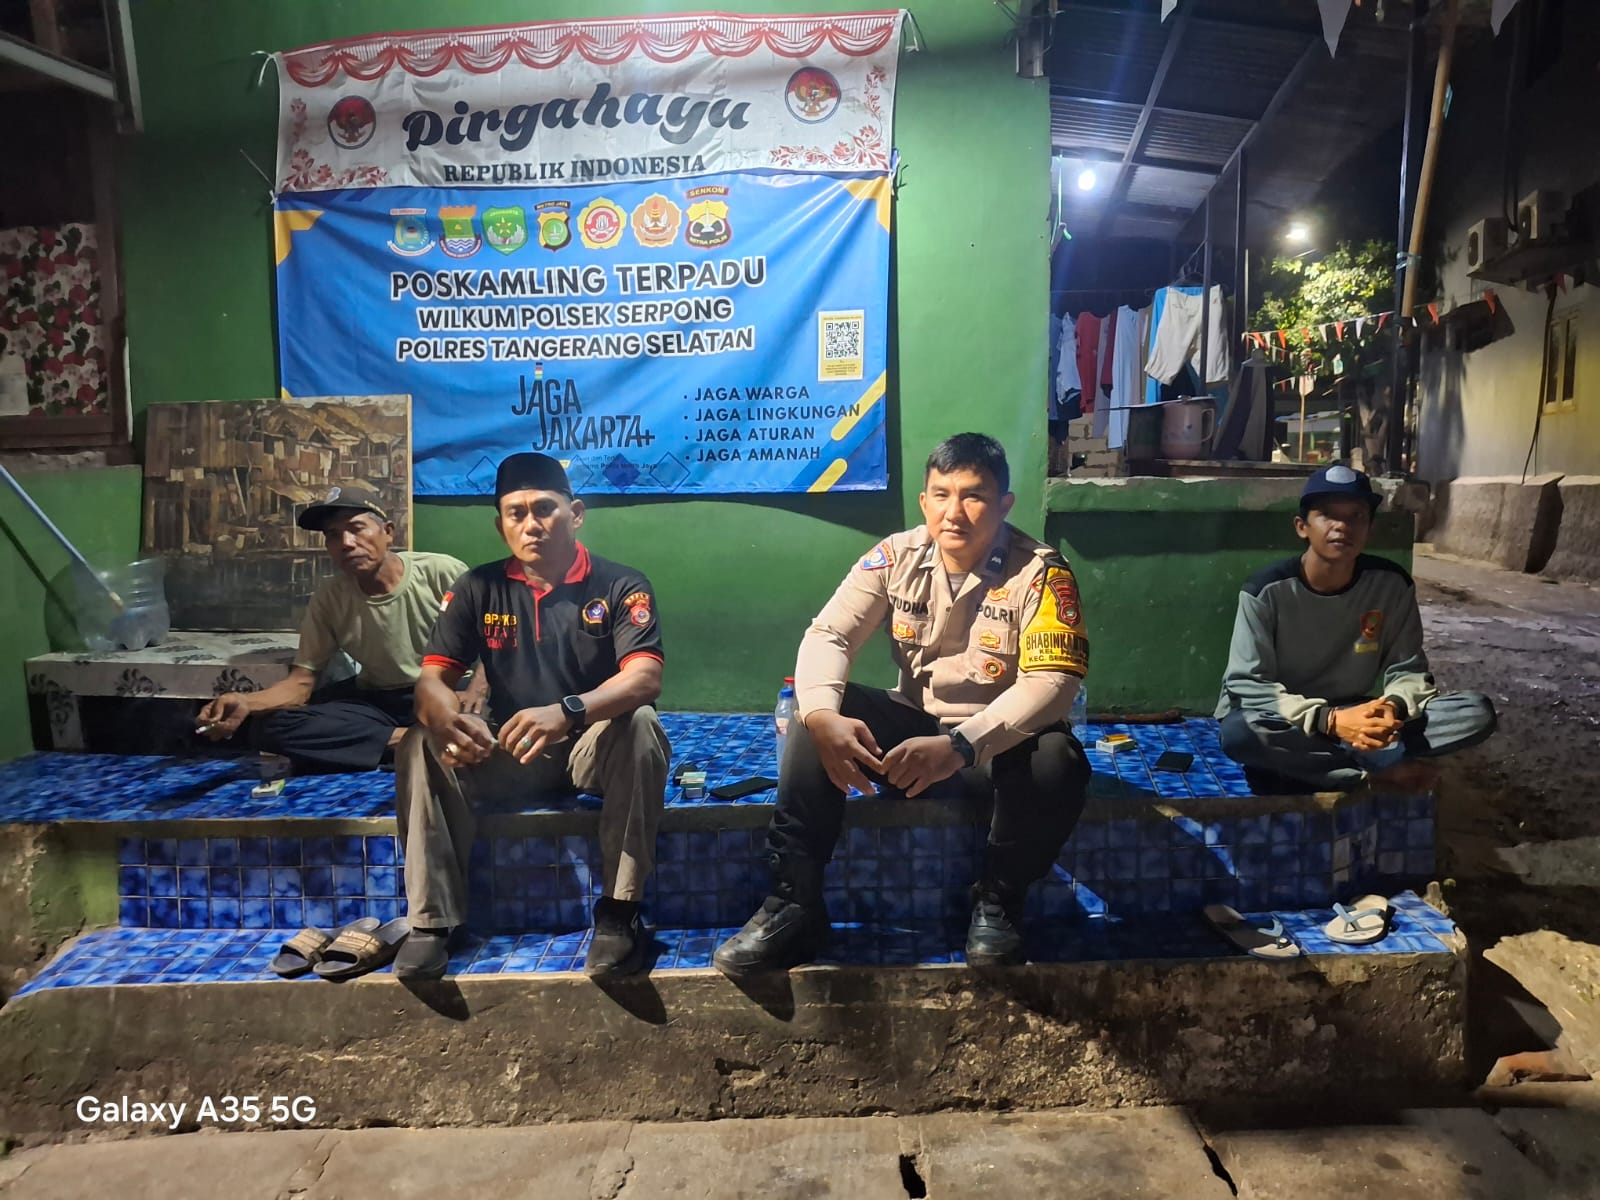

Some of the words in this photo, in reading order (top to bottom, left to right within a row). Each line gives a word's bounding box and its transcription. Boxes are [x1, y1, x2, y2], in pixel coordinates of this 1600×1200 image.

[402, 82, 752, 152] Dirgahayu
[444, 157, 566, 183] REPUBLIK
[571, 153, 706, 179] INDONESIA
[689, 186, 725, 197] SENKOM
[391, 265, 605, 300] POSKAMLING
[614, 255, 767, 294] TERPADU
[418, 306, 517, 331] WILKUM
[521, 303, 611, 329] POLSEK
[615, 297, 734, 326] SERPONG
[396, 336, 486, 361] POLRES
[491, 333, 641, 361] TANGERANG
[645, 325, 755, 356] SELATAN
[512, 375, 582, 416] JAGA
[695, 387, 740, 402] JAGA
[745, 386, 810, 401] WARGA
[695, 407, 742, 422] JAGA
[747, 403, 861, 421] LINGKUNGAN
[696, 428, 742, 443] JAGA
[747, 426, 815, 441] ATURAN
[696, 448, 743, 463] JAGA
[747, 446, 821, 462] AMANAH
[976, 602, 1014, 624] POLRI
